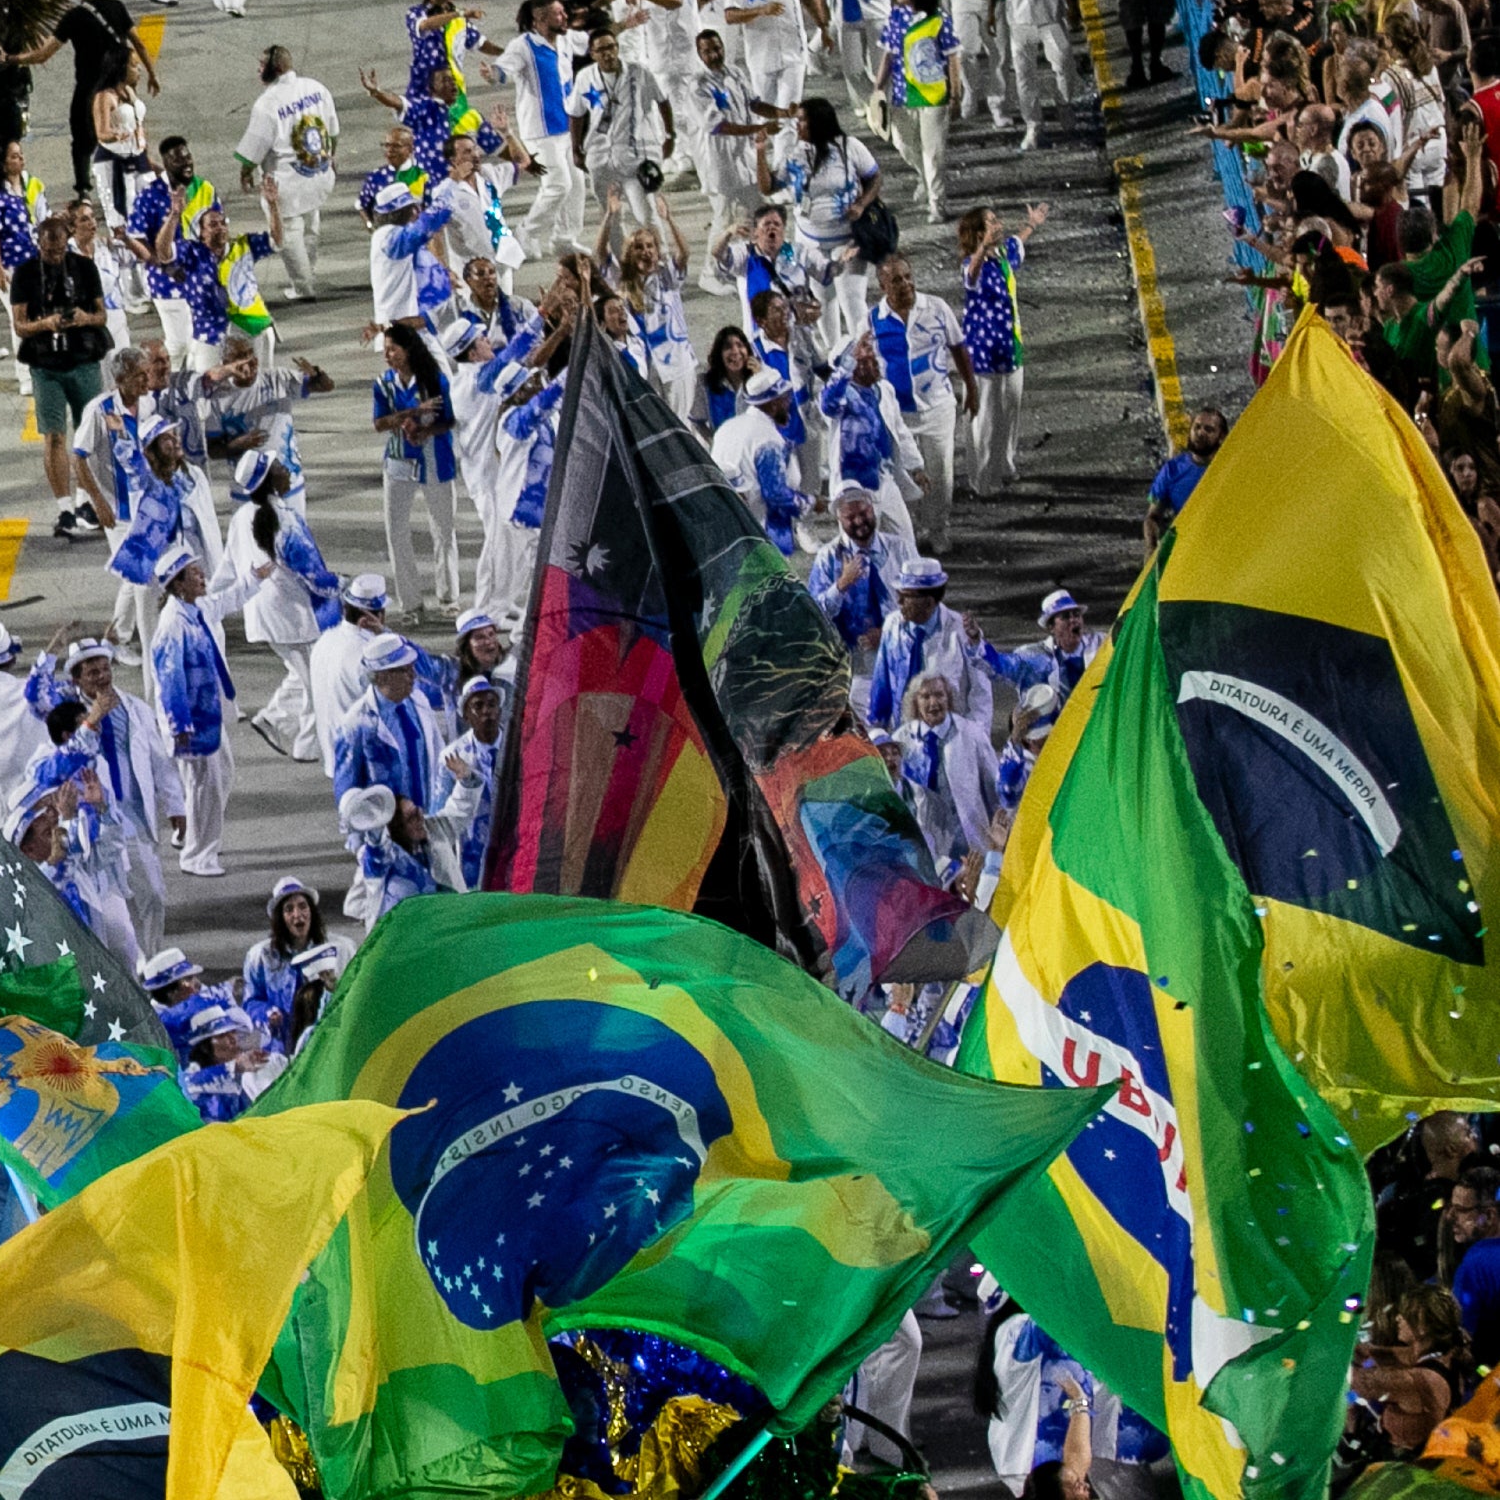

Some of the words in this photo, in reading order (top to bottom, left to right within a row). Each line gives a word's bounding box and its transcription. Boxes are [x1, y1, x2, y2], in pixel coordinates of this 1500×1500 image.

[1208, 678, 1290, 726] DITATDURA
[1290, 718, 1305, 735] É
[1302, 729, 1336, 762] UMA
[1334, 757, 1378, 810] MERDA
[22, 1422, 101, 1467] DITATDURA
[100, 1417, 113, 1434] É
[113, 1412, 157, 1433] UMA
